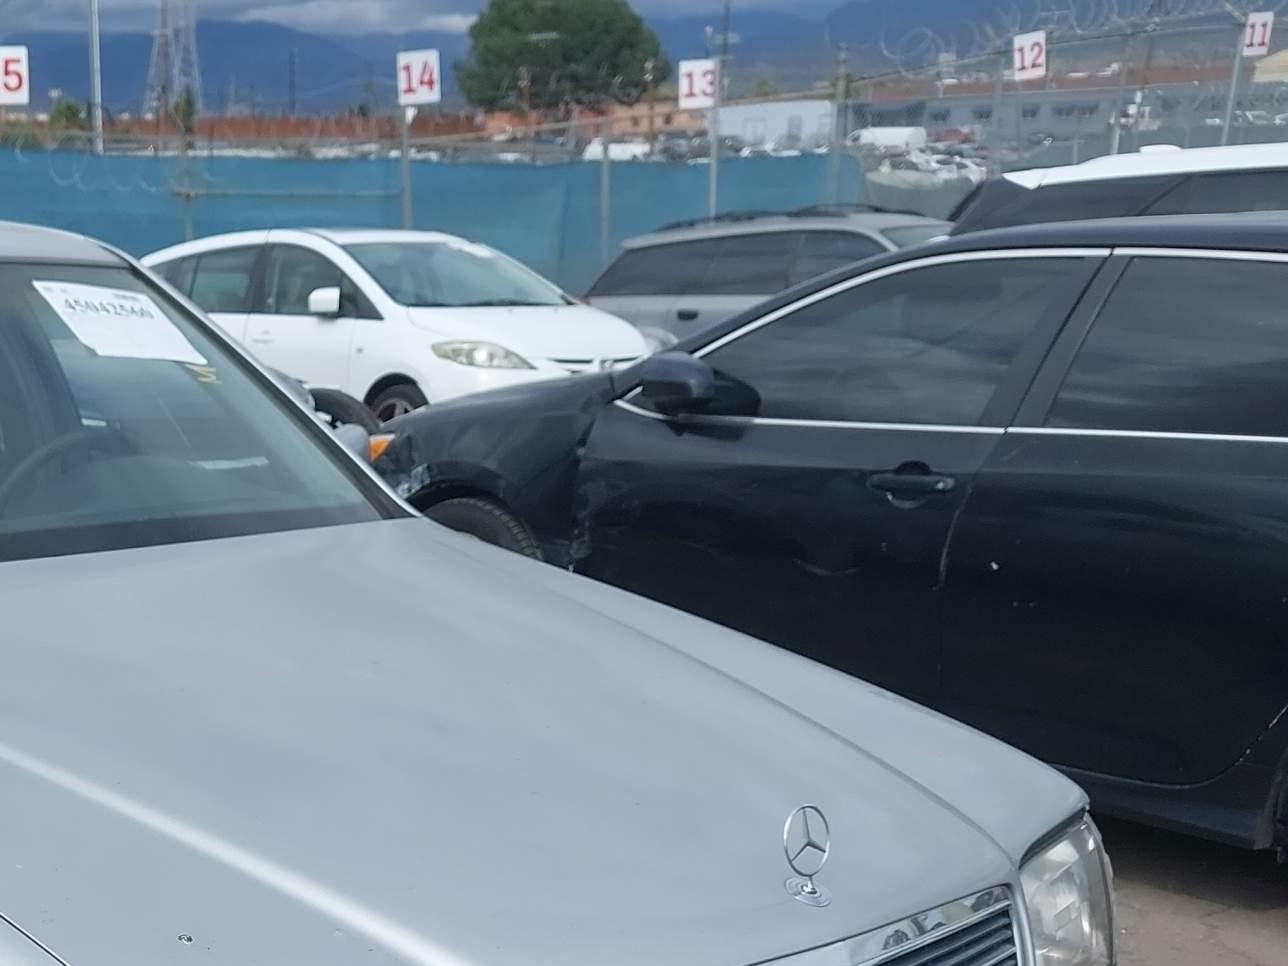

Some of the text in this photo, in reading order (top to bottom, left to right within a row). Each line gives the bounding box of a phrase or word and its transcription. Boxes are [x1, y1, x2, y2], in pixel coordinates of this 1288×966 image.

[1245, 20, 1269, 48] 11
[1016, 42, 1043, 72] 12
[401, 60, 436, 94] 14
[682, 68, 716, 98] 13
